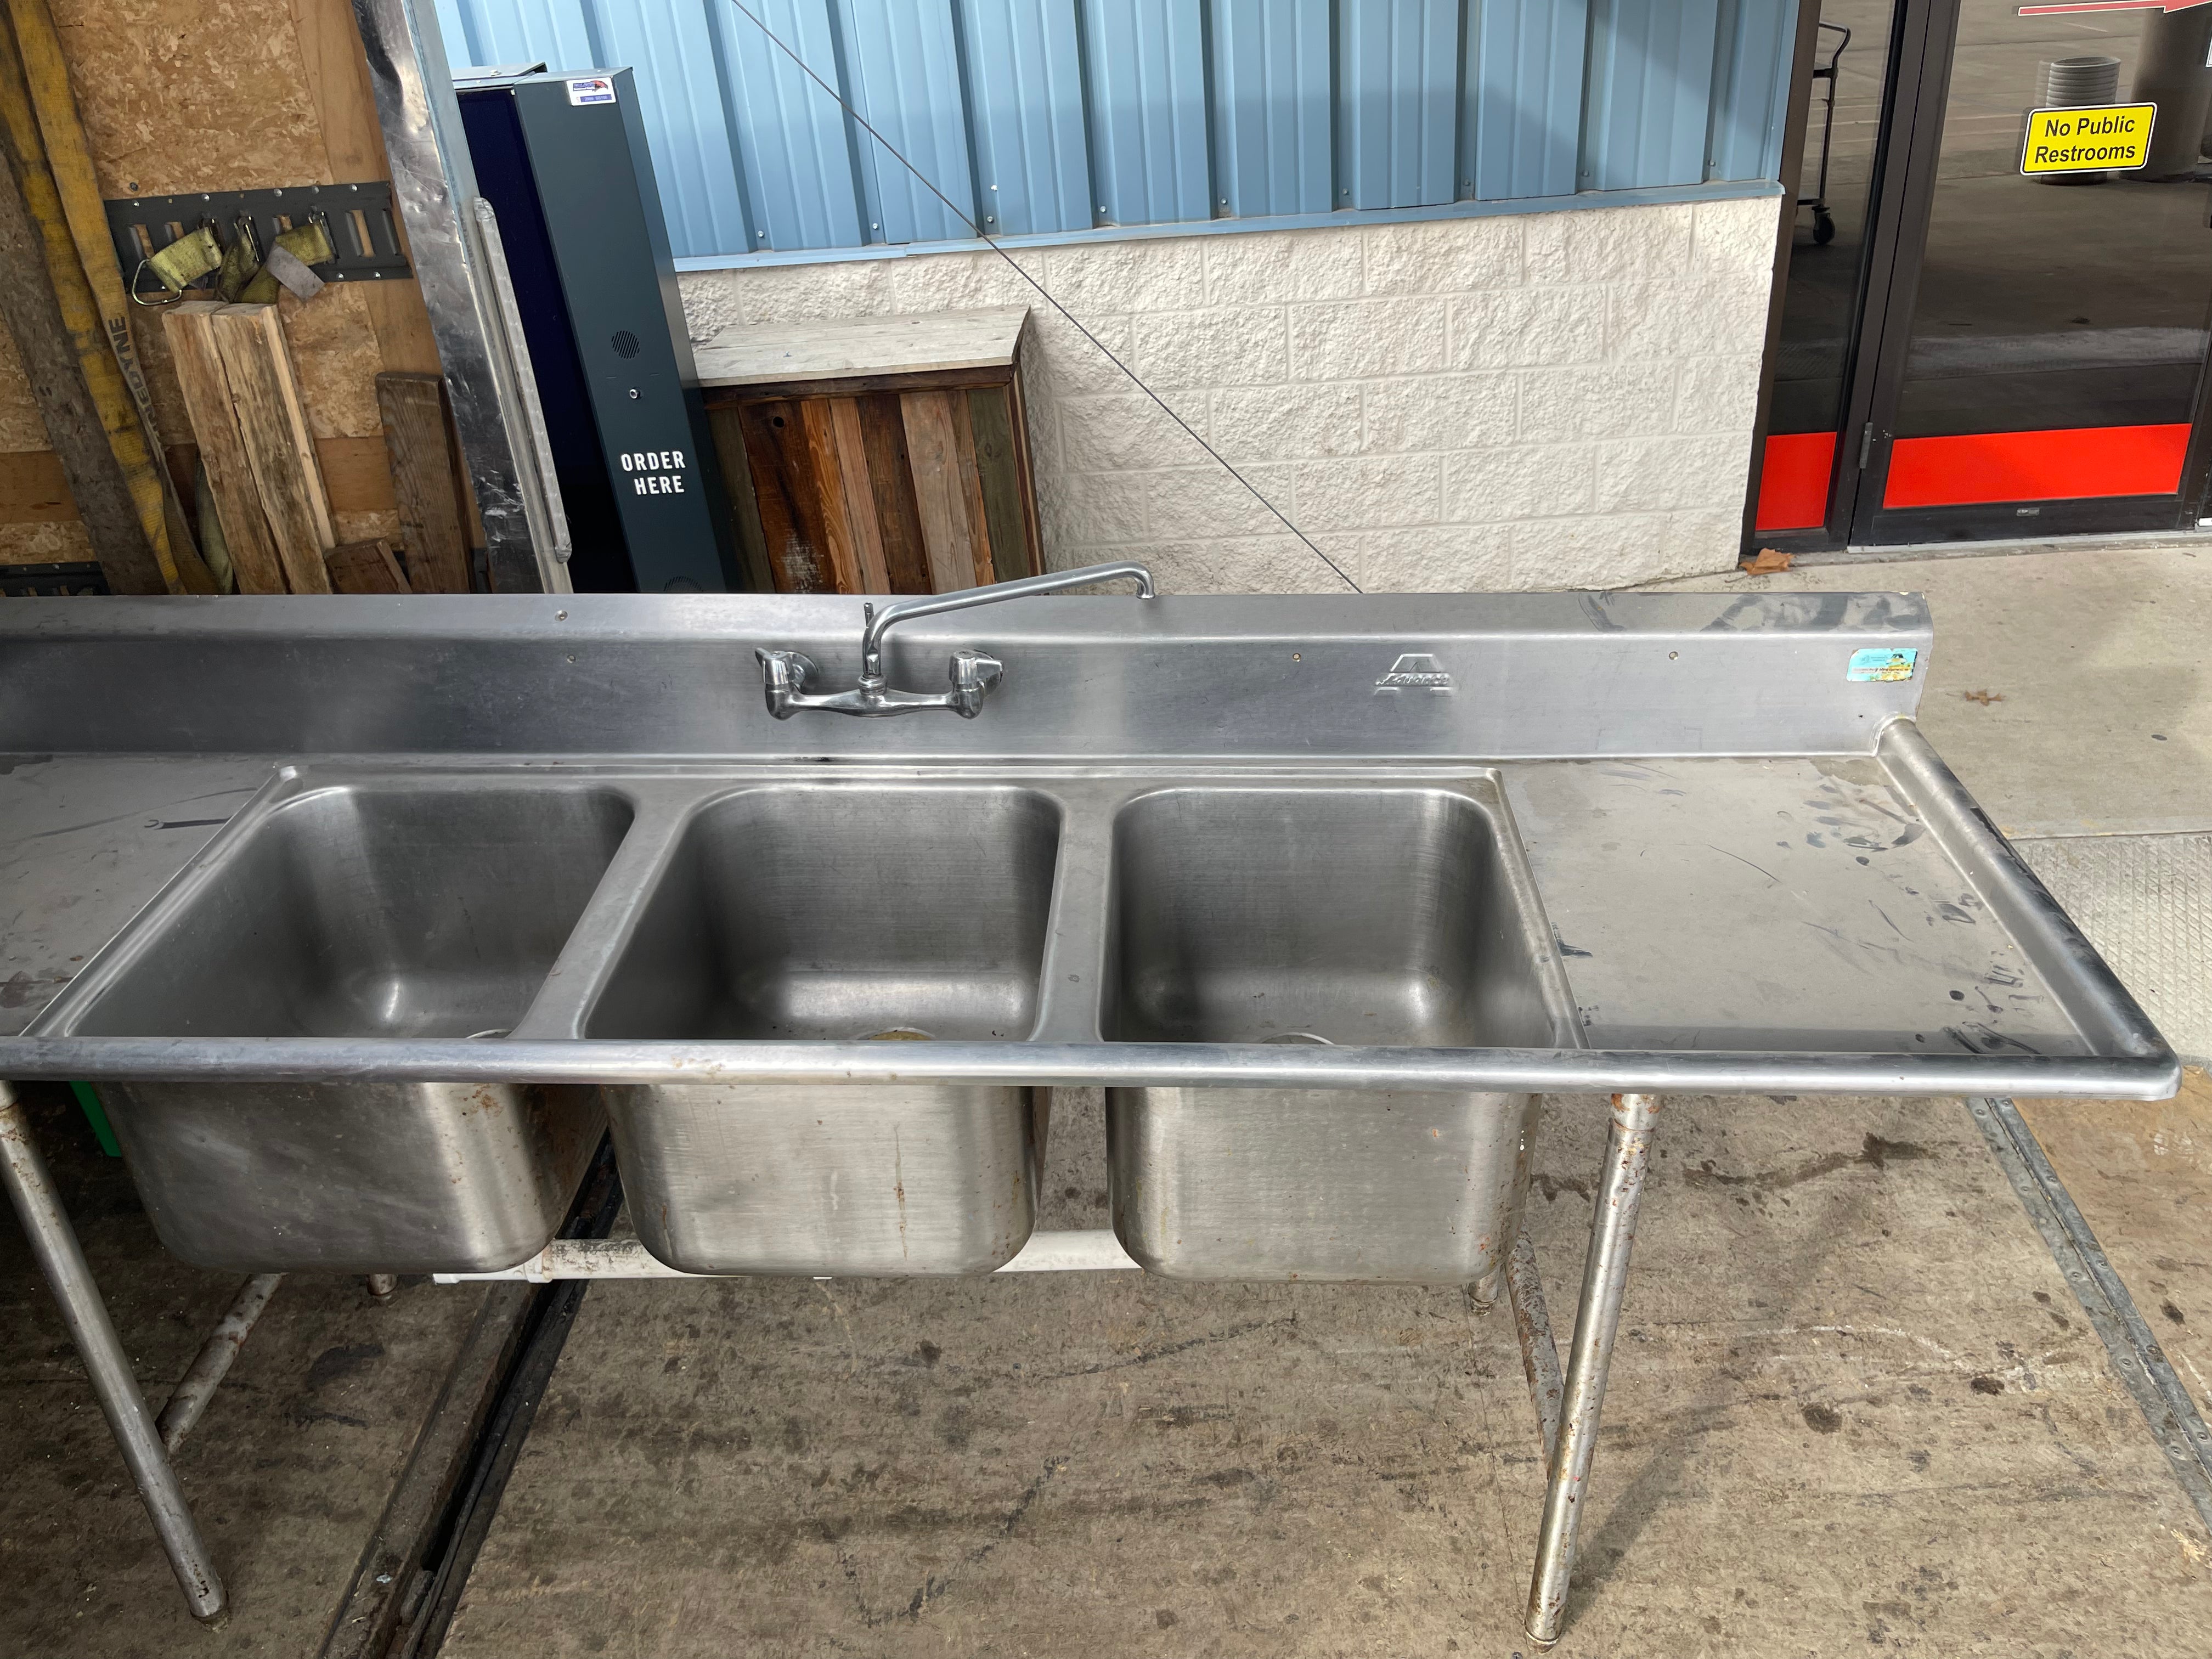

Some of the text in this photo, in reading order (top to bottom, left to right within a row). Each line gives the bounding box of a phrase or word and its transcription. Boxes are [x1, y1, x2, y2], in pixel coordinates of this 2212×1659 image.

[2045, 115, 2135, 137] No Public
[2034, 145, 2136, 163] Restrooms
[620, 450, 686, 472] ORDER
[634, 475, 685, 495] HERE
